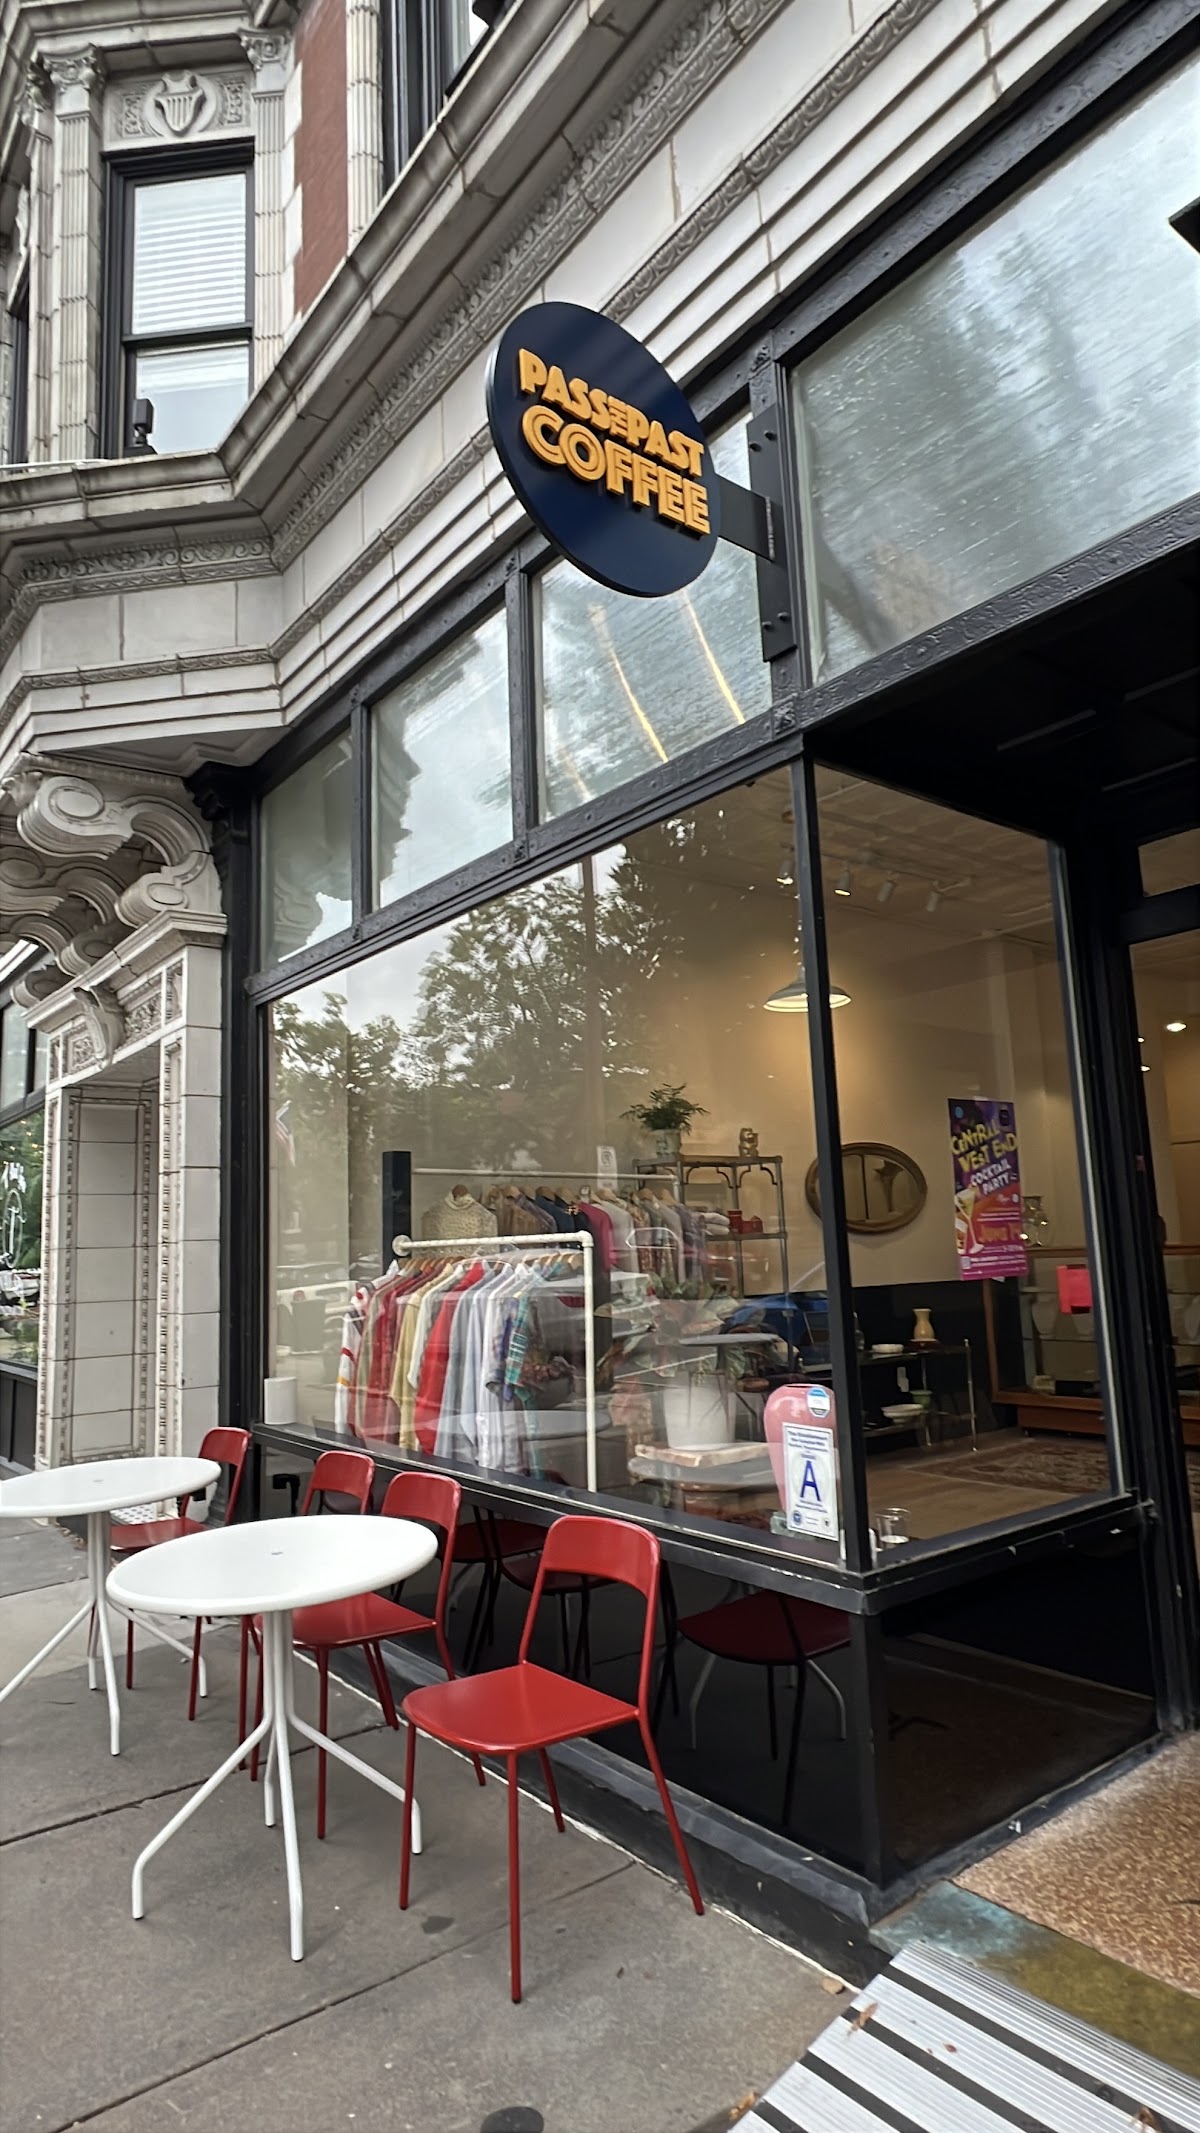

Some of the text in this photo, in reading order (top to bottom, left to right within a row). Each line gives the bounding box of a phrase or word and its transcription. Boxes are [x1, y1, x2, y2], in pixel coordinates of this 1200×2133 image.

[522, 405, 711, 534] COFFEE
[971, 1158, 1011, 1186] COCKTAIL
[983, 1172, 1009, 1195] PARTY
[800, 1460, 821, 1501] A
